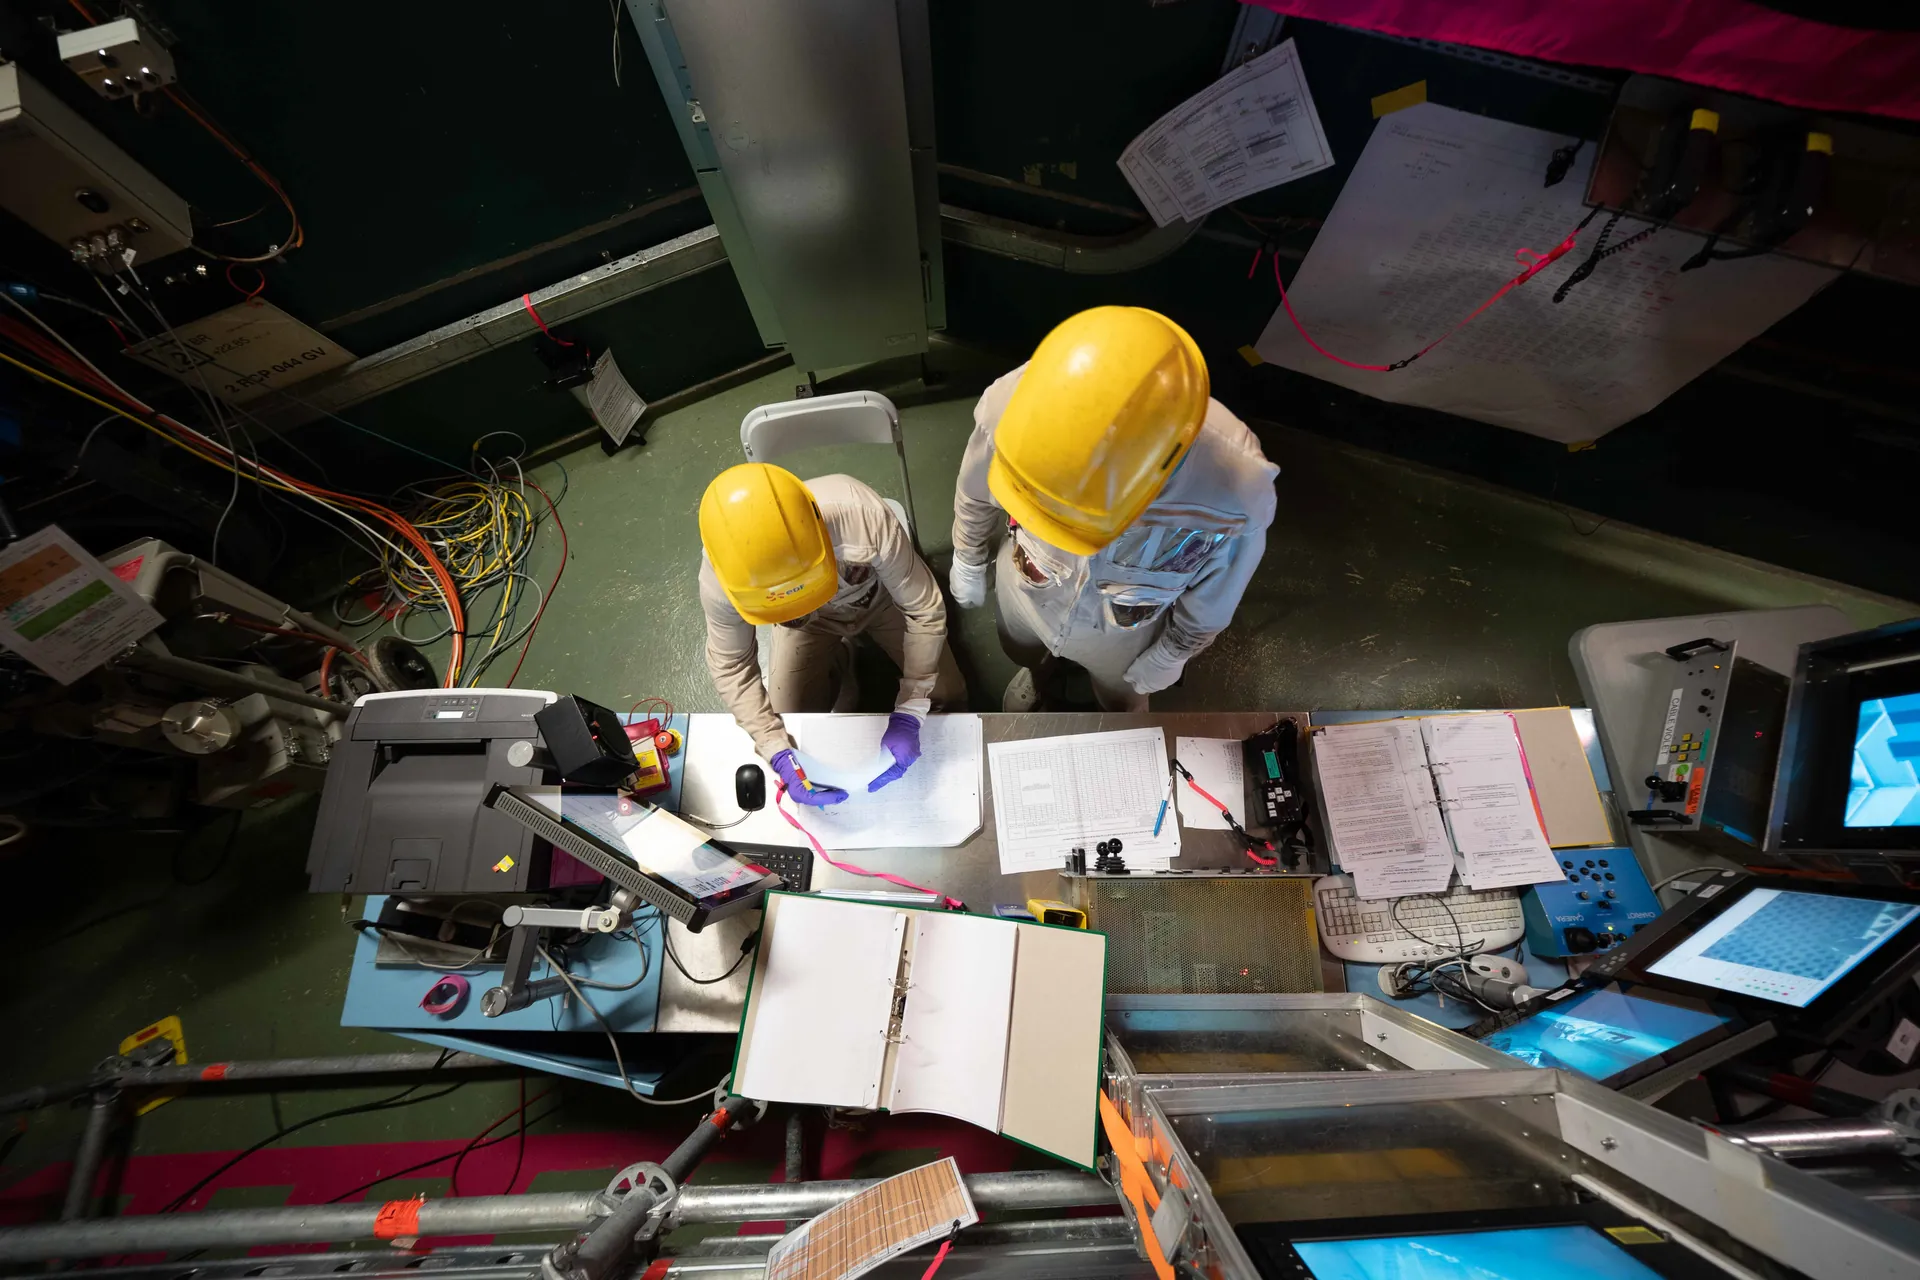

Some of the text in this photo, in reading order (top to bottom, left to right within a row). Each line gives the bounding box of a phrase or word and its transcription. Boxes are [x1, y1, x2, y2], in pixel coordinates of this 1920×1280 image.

[224, 346, 327, 394] 2 RCP 044 GV
[1661, 697, 1680, 755] CABLE VIOLET
[1627, 911, 1656, 920] CHARIOT
